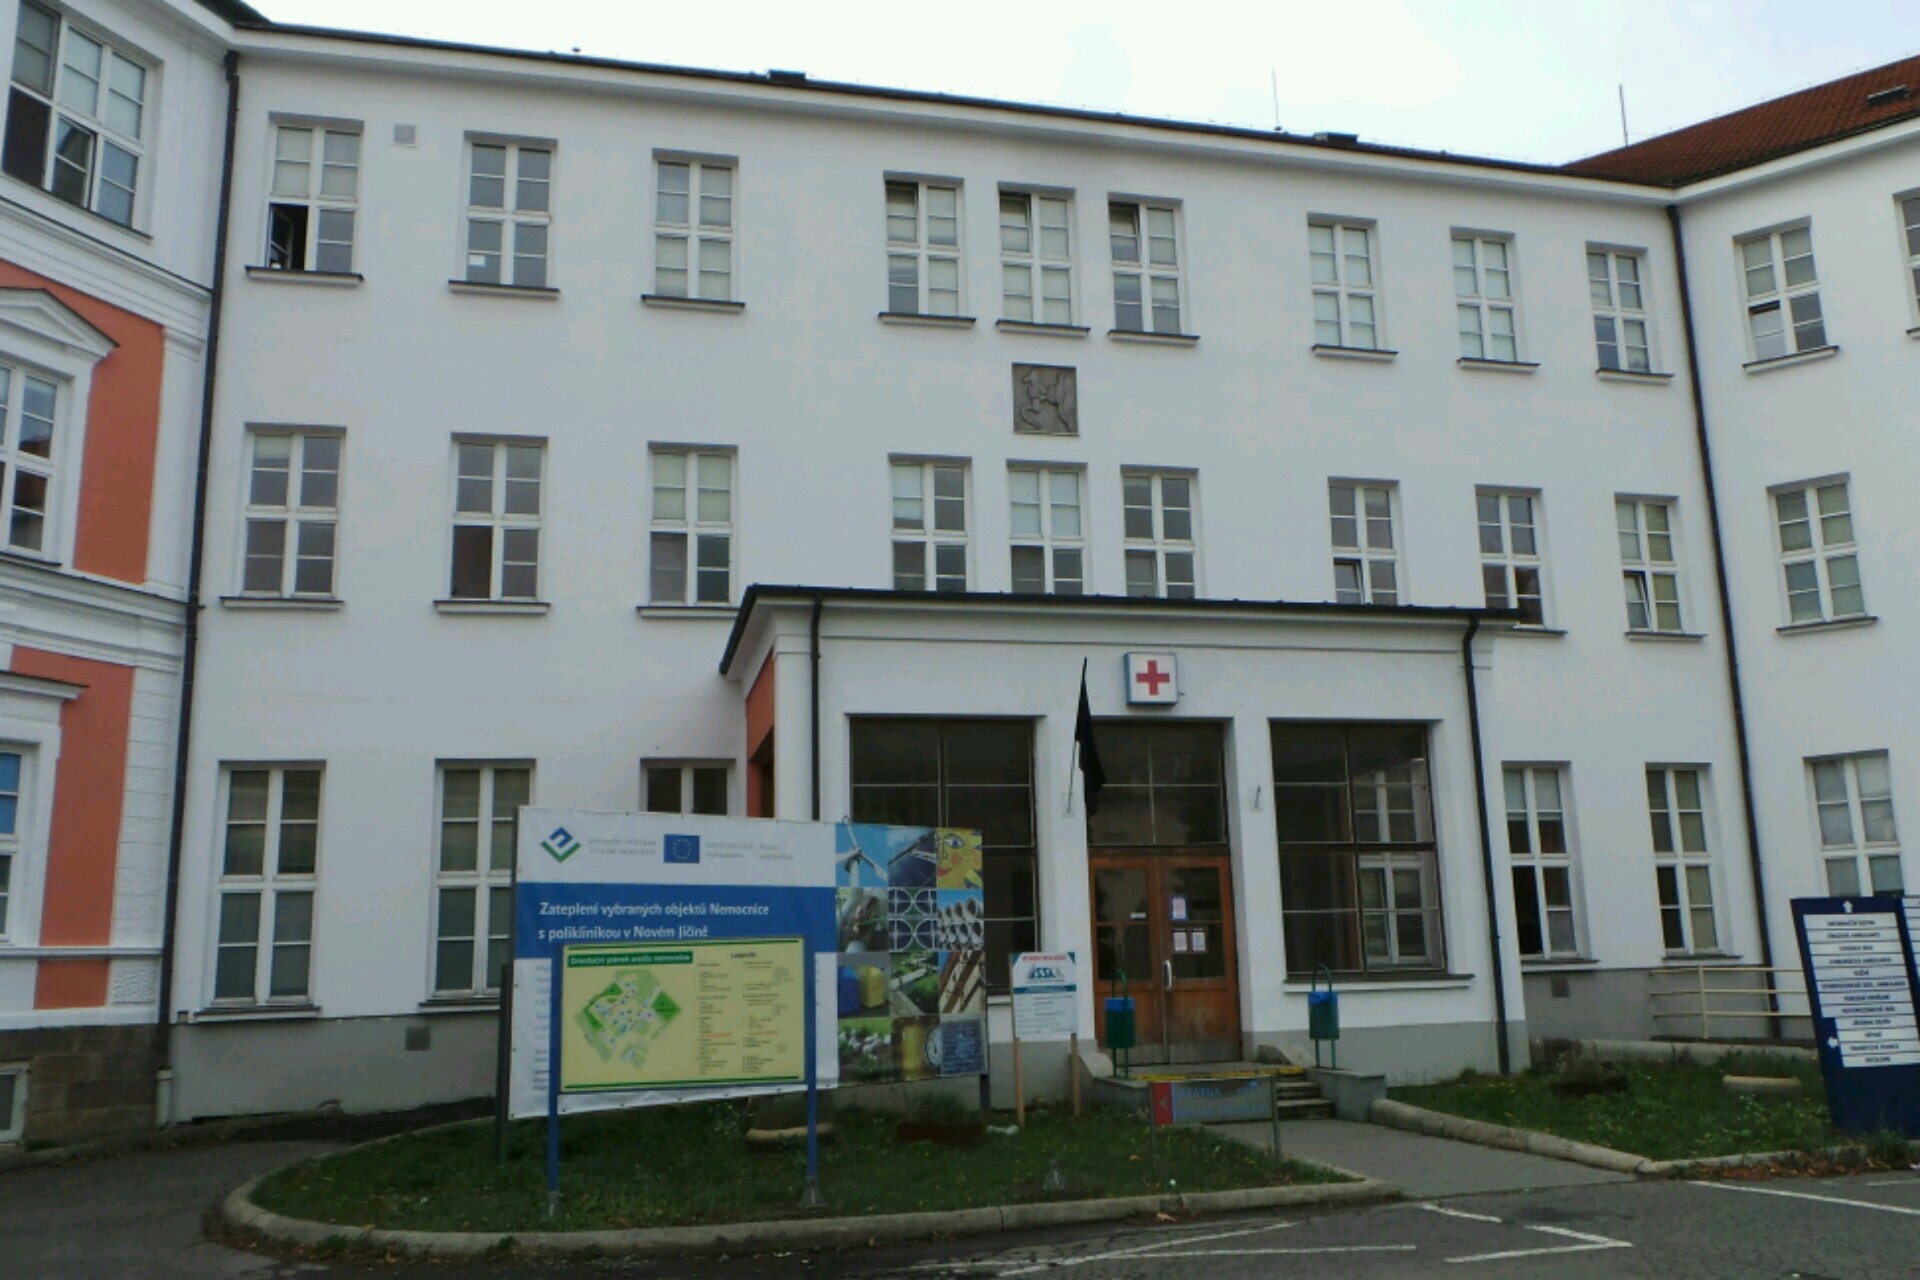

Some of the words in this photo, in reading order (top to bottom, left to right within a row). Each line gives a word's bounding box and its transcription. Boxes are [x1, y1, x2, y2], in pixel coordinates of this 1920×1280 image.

[538, 901, 600, 917] Zateplení
[600, 901, 663, 918] vybraných
[664, 901, 707, 917] objektů
[708, 901, 770, 916] Nemocnice
[538, 929, 546, 939] s
[548, 925, 622, 942] poliklinikou
[623, 929, 631, 939] v
[633, 925, 675, 939] Novém
[678, 925, 709, 939] Jičíně
